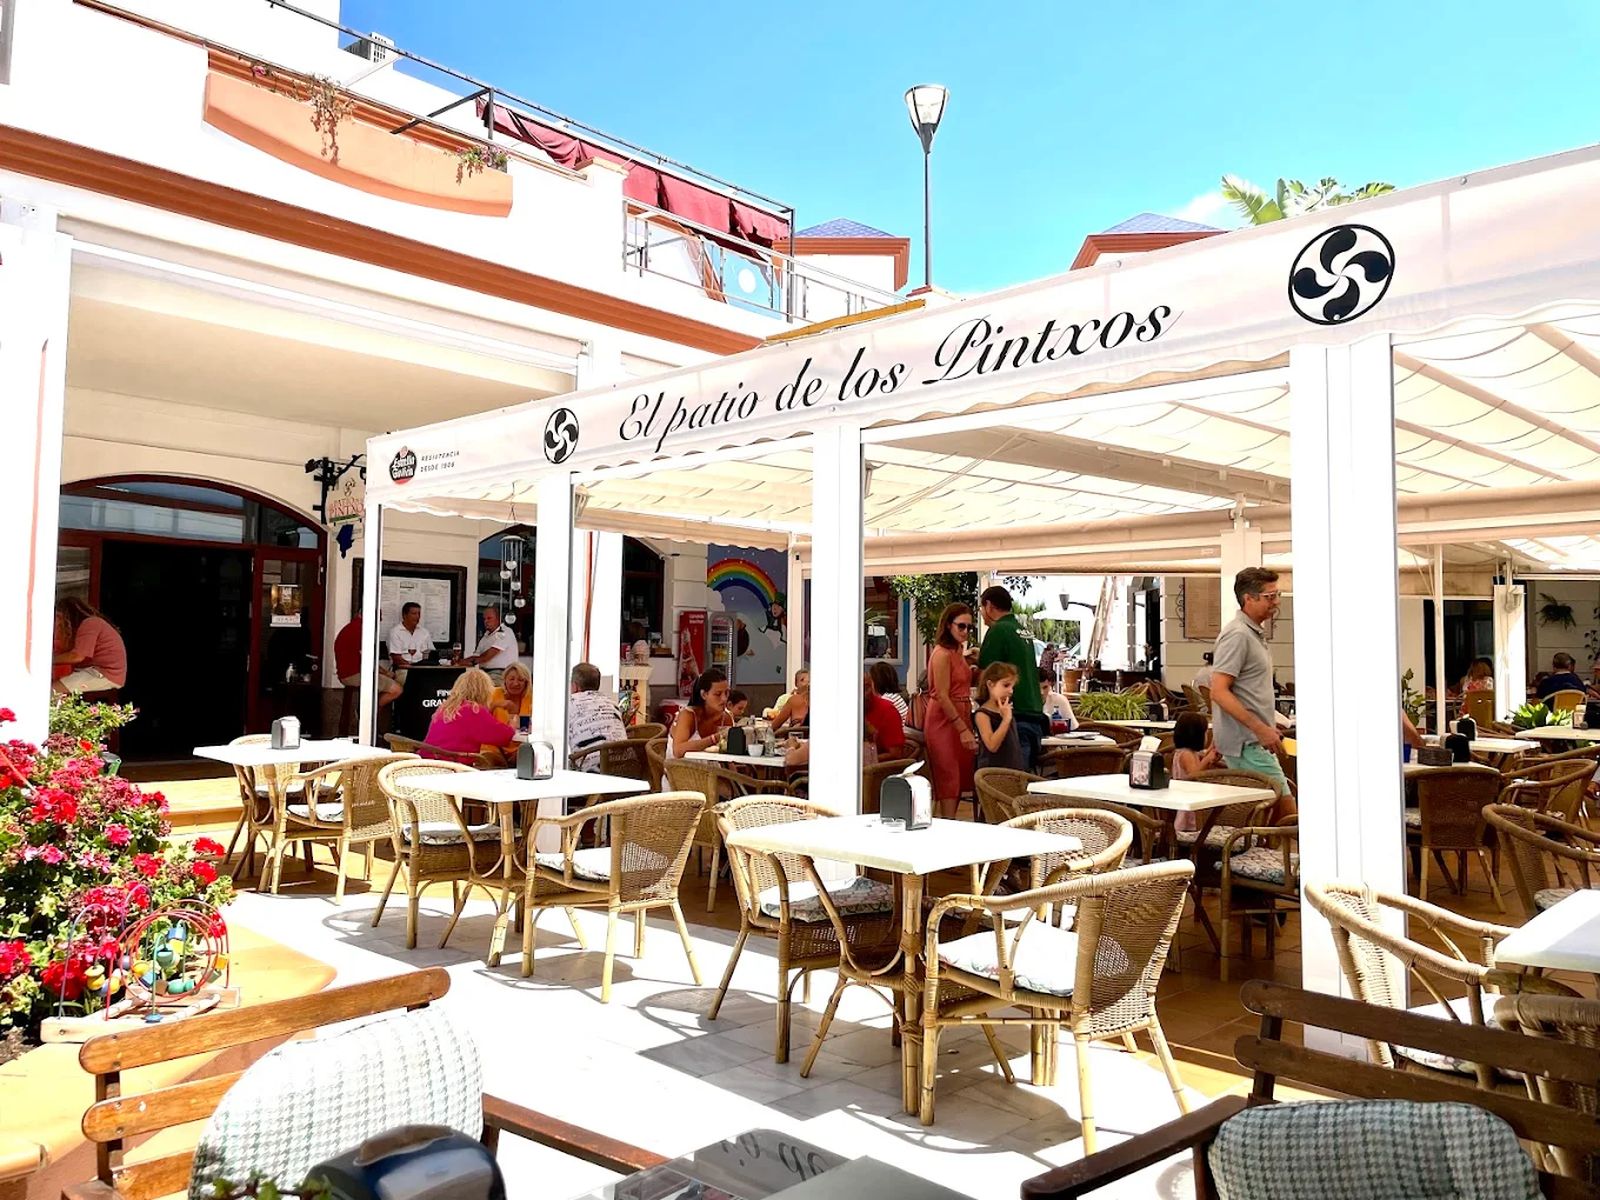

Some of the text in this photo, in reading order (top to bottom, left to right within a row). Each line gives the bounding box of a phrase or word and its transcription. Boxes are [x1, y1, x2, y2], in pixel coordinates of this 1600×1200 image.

[619, 304, 1184, 453] El patio de los Pintxos
